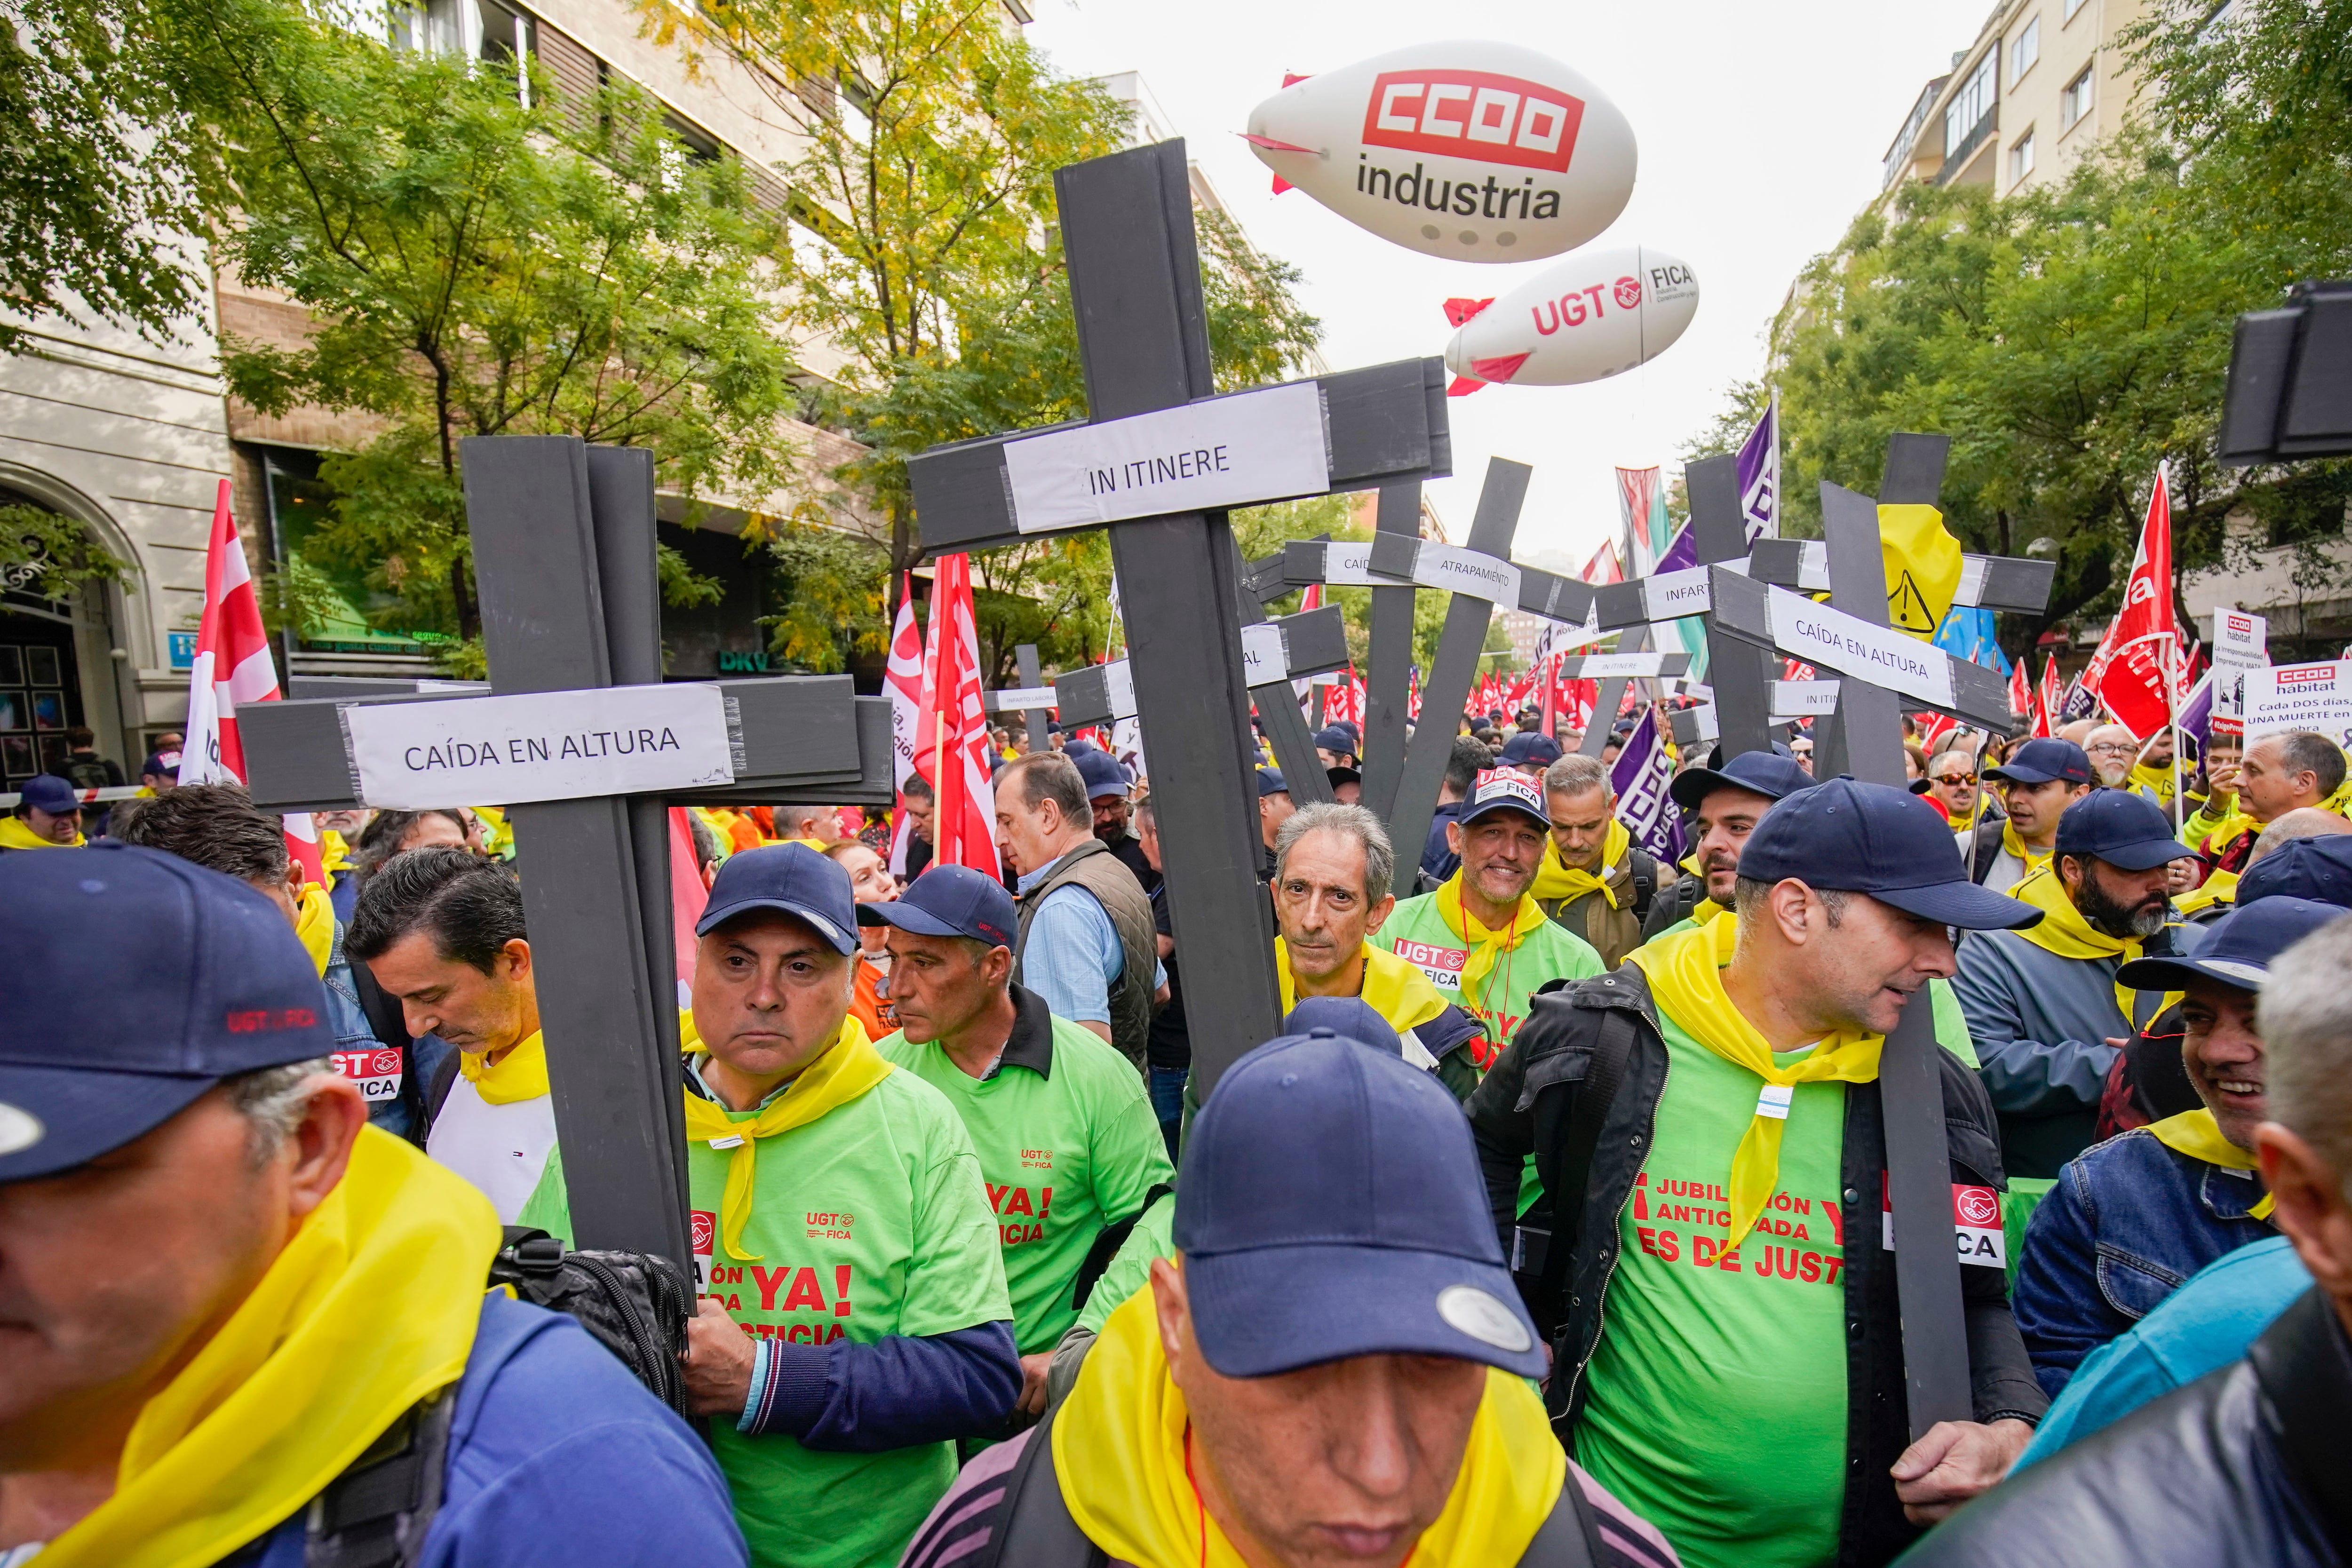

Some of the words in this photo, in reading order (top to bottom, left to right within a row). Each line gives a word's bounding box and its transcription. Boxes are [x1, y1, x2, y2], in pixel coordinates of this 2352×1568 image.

[1377, 83, 1567, 153] CCOO
[1358, 152, 1560, 219] industria
[1650, 265, 1693, 288] FICA
[1532, 283, 1605, 335] UGT
[1089, 467, 1115, 495] IN
[1124, 446, 1230, 489] ITINERE
[1440, 560, 1509, 587] ATRAPAMIENTO
[2229, 617, 2250, 631] CCOO
[2227, 629, 2250, 644] hábitat
[1796, 620, 1843, 650] CAÍDA
[1847, 638, 1866, 658] EN
[1871, 648, 1929, 679] ALTURA
[720, 650, 768, 672] DKV
[2216, 656, 2245, 669] Empresarial,
[2280, 668, 2332, 682] CCOO
[2277, 681, 2336, 694] hábitat
[1807, 695, 1817, 704] IN
[2259, 701, 2288, 711] Cada
[2293, 699, 2319, 708] DOS
[2248, 715, 2275, 724] UNA
[2279, 711, 2329, 721] MUERTE
[404, 737, 500, 771] CAÍDA
[509, 737, 549, 764] EN
[561, 726, 680, 760] ALTURA
[1479, 766, 1518, 785] UGT
[1507, 782, 1538, 805] FICA
[1396, 939, 1443, 965] UGT
[227, 1011, 267, 1033] UGT
[353, 1079, 396, 1097] ICA
[1021, 1149, 1043, 1160] UGT
[985, 1183, 1052, 1219] YA!
[1656, 1178, 1811, 1216] JUBILIÓN
[806, 1212, 839, 1226] UGT
[1657, 1203, 1810, 1241] ANTICADA
[826, 1230, 851, 1240] FICA
[1637, 1226, 1680, 1262] ES
[1693, 1235, 1741, 1273] DE
[749, 1265, 852, 1317] YA!
